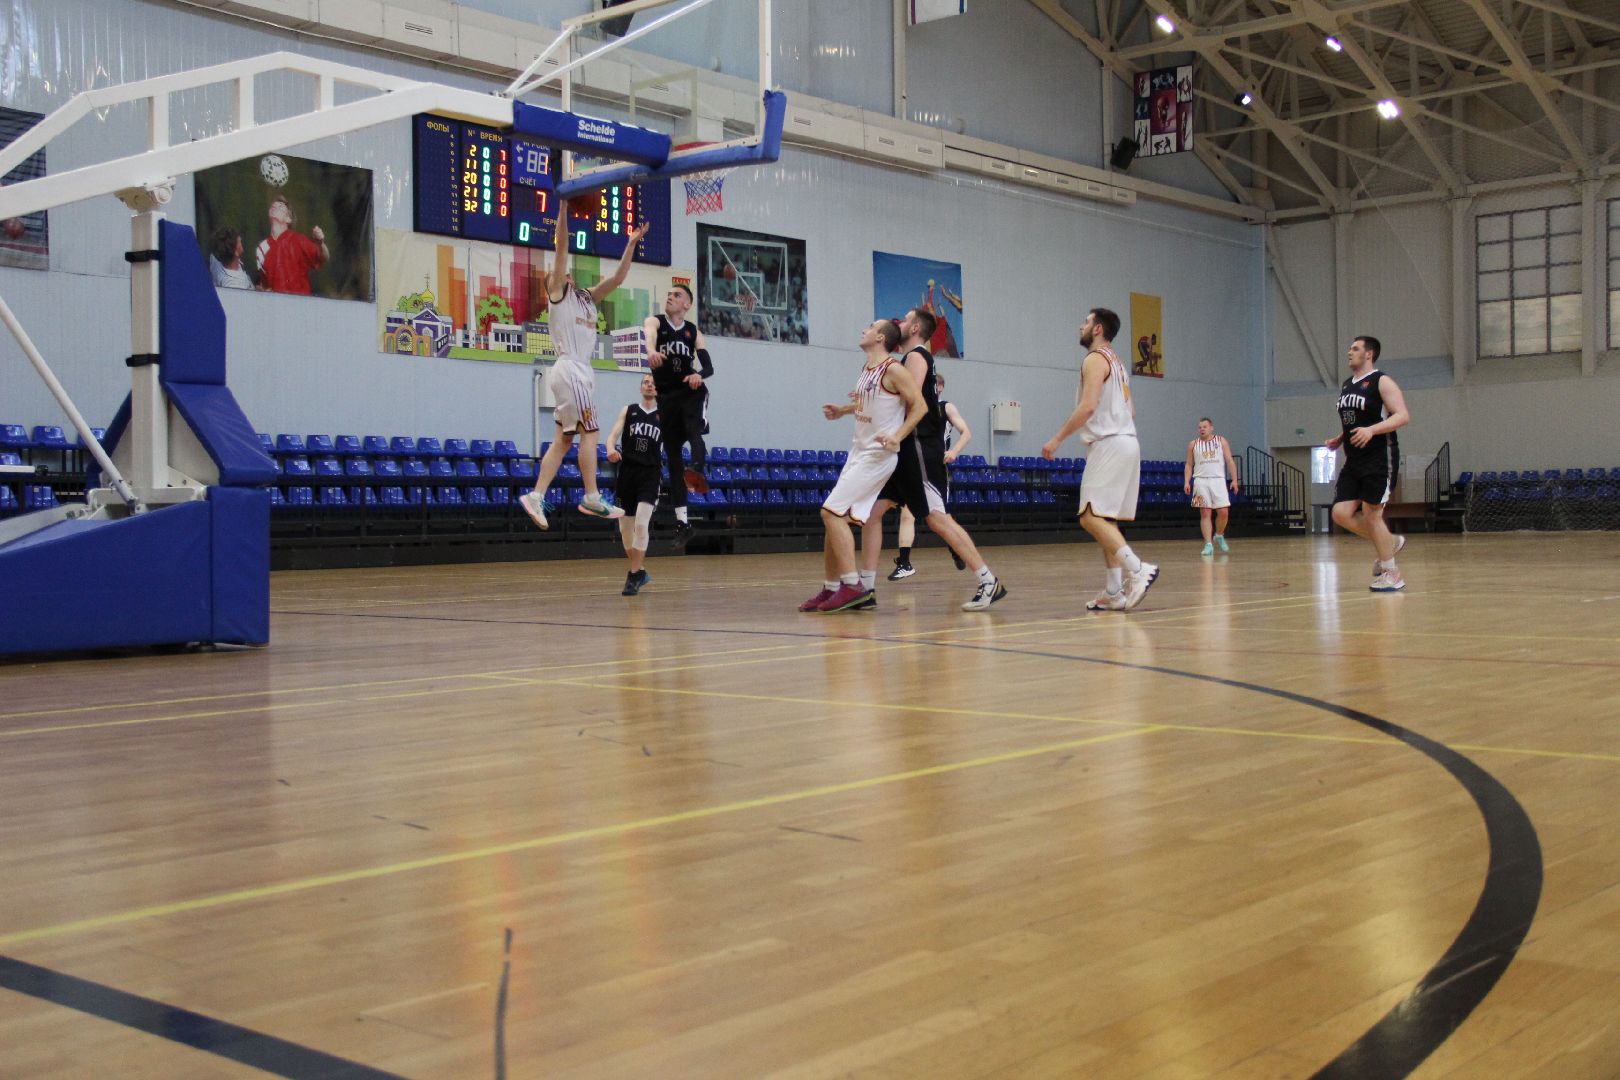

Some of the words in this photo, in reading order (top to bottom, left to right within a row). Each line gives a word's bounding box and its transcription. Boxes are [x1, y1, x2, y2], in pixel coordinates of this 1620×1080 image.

[426, 121, 449, 133] ФОЛЫ
[578, 120, 616, 137] Schelde
[480, 131, 503, 143] ВРЕМЯ
[577, 131, 615, 144] International
[470, 145, 477, 157] 2
[482, 147, 490, 159] 0
[500, 149, 506, 161] 7
[466, 158, 477, 170] 11
[483, 160, 490, 173] 0
[500, 164, 507, 175] 0
[463, 171, 477, 185] 20
[483, 174, 491, 187] 0
[500, 177, 507, 189] 0
[463, 185, 478, 198] 21
[483, 188, 491, 201] 0
[500, 191, 507, 203] 0
[626, 186, 633, 197] 0
[464, 199, 478, 212] 32
[484, 201, 491, 215] 0
[501, 205, 507, 217] 0
[536, 189, 548, 213] 7
[612, 196, 619, 209] 0
[626, 199, 633, 211] 0
[600, 208, 608, 219] 8
[612, 209, 619, 221] 0
[626, 212, 633, 224] 0
[518, 222, 530, 242] 0
[595, 219, 608, 232] 34
[612, 222, 620, 234] 0
[627, 224, 634, 236] 0
[576, 230, 587, 250] 0
[629, 422, 661, 442] БКПП
